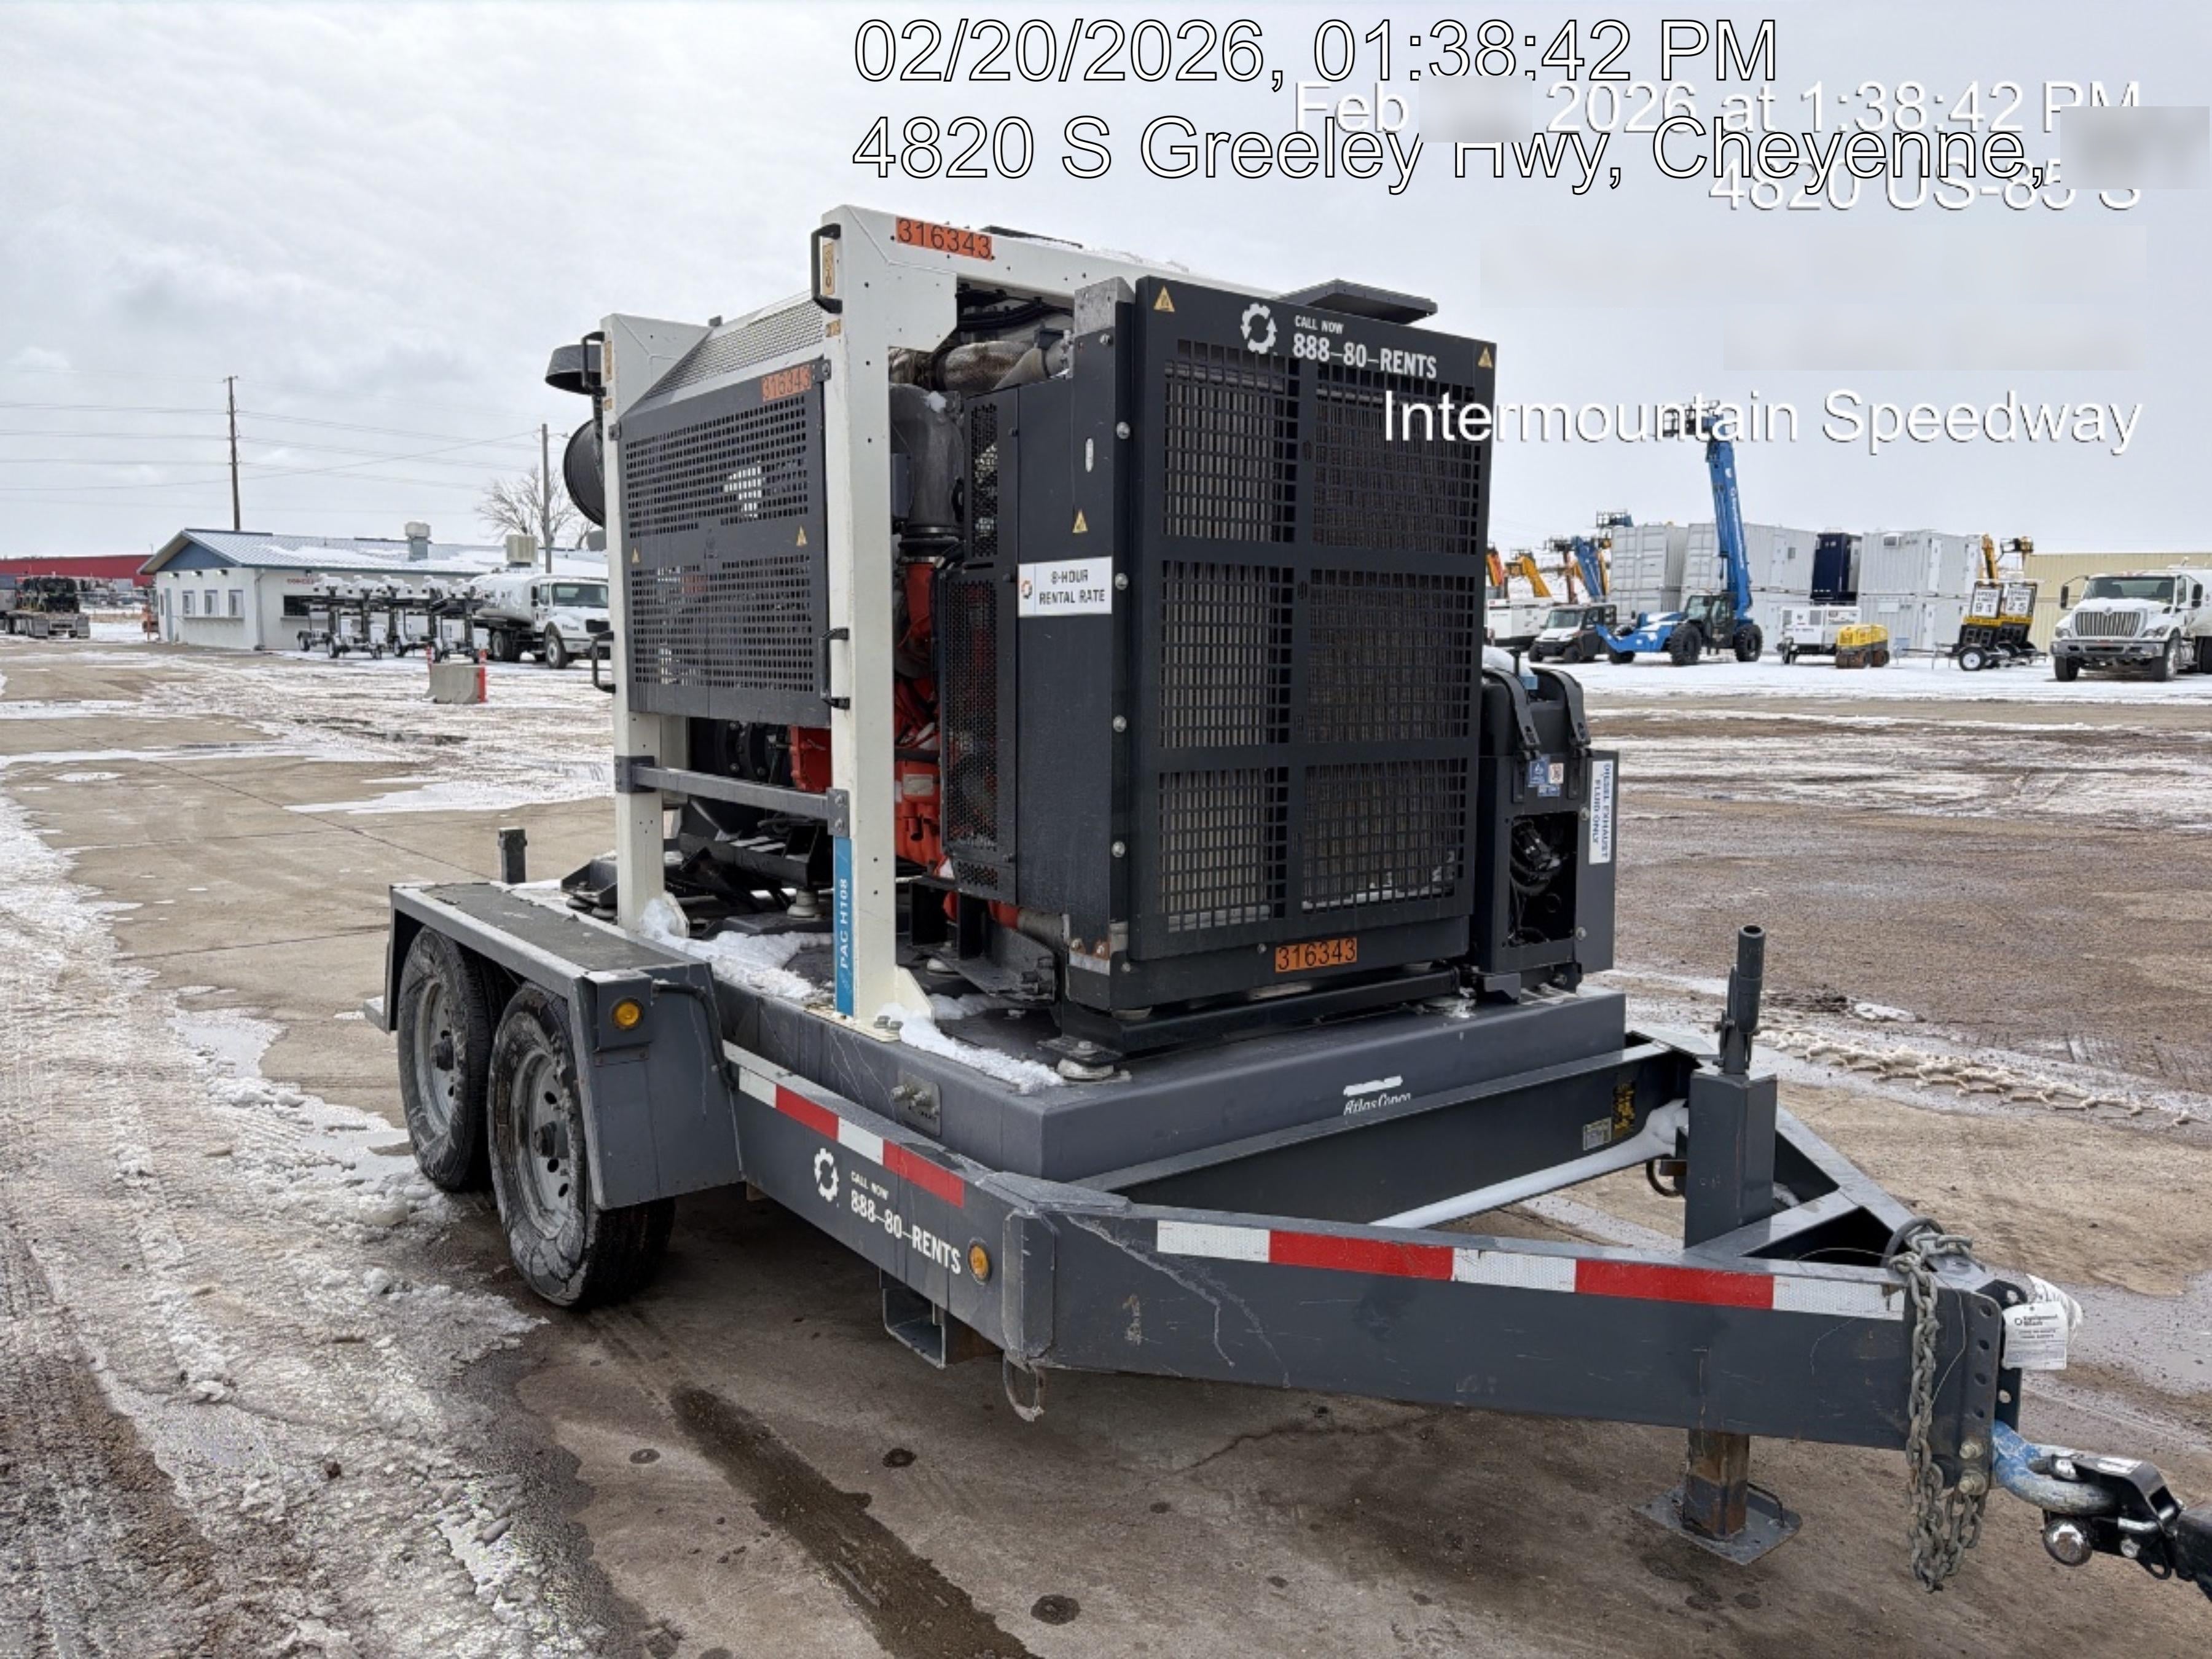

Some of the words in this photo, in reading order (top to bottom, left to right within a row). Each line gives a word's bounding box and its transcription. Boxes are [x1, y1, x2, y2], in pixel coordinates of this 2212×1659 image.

[898, 218, 991, 259] 316343
[1294, 315, 1319, 330] CALL
[1321, 320, 1344, 334] NOW
[1292, 332, 1437, 379] 888-80-RENTS
[1051, 569, 1089, 585] 8-HOUR
[1039, 590, 1076, 605] RENTAL
[1079, 589, 1105, 603] RATE
[1592, 815, 1601, 844] ONLY
[1601, 806, 1610, 858] EXHAUST
[839, 930, 849, 969] PAC
[1277, 939, 1356, 970] 316343
[850, 1170, 869, 1190] CALL
[871, 1182, 889, 1201] NOW
[850, 1188, 962, 1274] 888-80-RENTS
